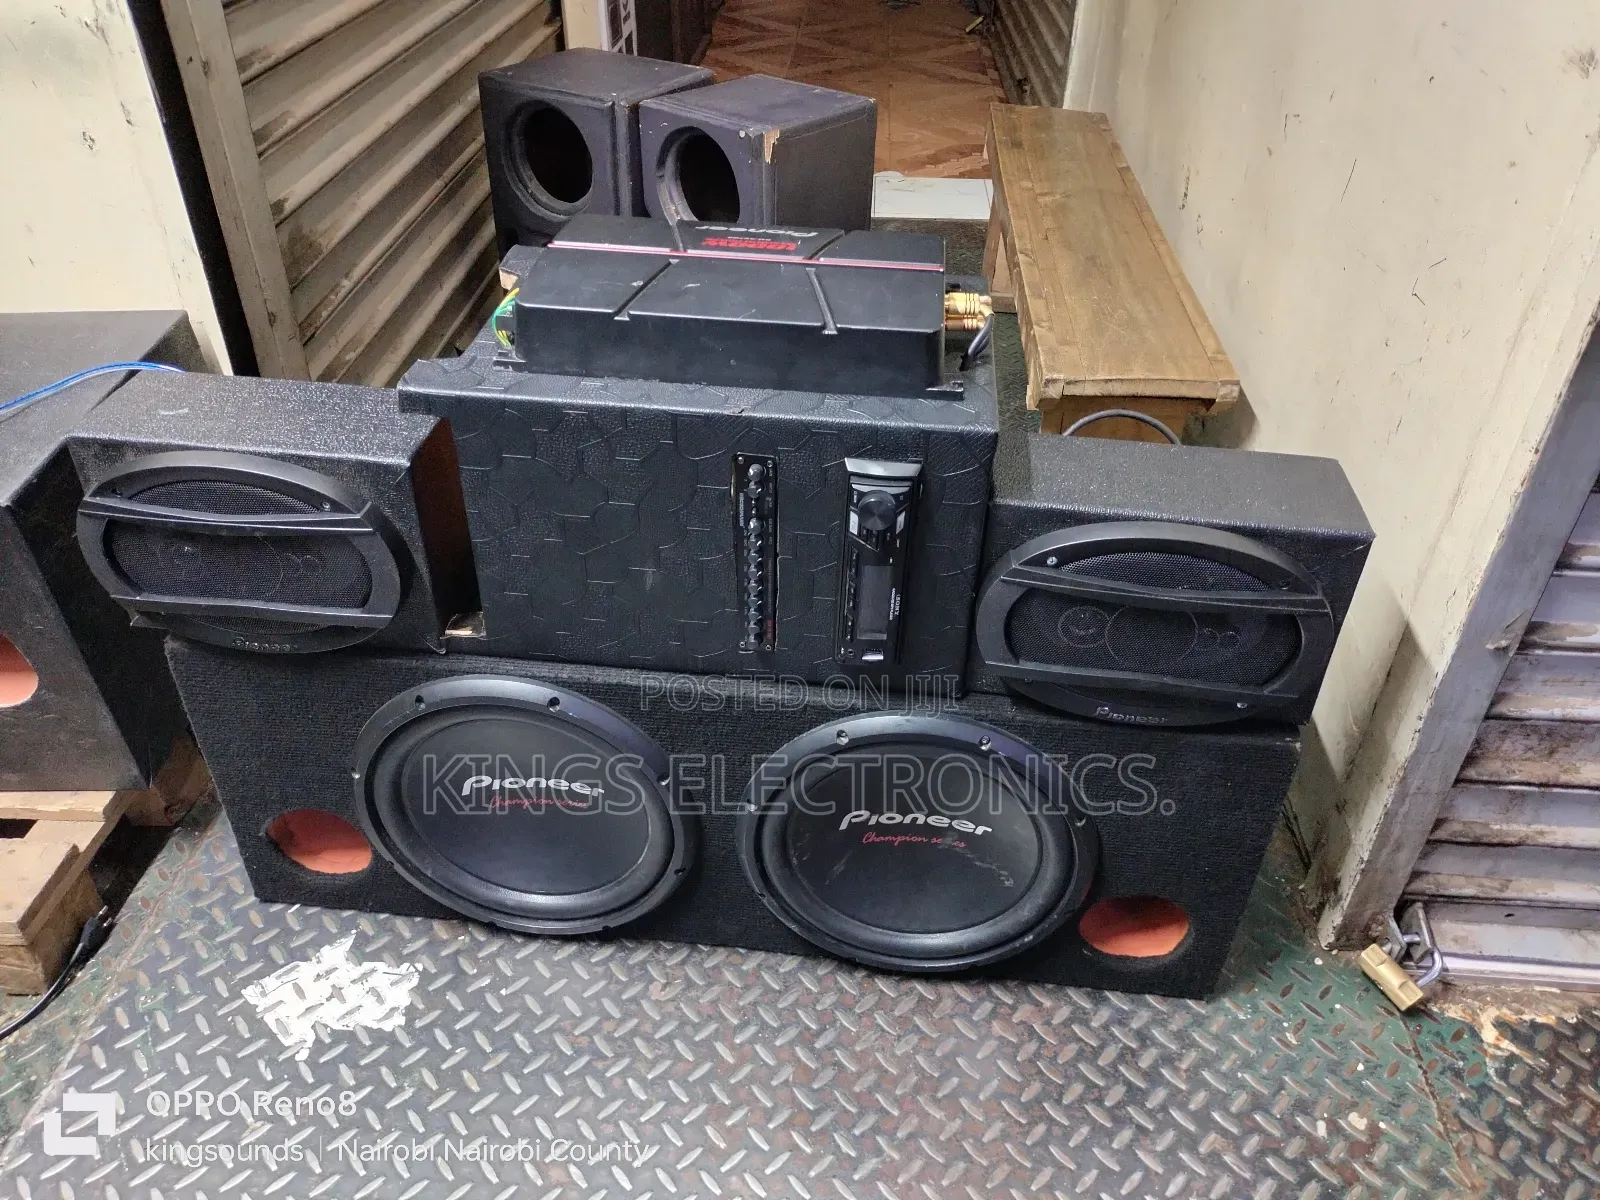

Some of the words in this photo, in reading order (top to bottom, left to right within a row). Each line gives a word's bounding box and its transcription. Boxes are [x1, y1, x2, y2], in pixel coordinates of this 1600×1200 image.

[695, 225, 819, 237] Pioneer
[1094, 706, 1168, 724] Pioneer
[461, 775, 605, 797] Pioneer
[838, 809, 993, 836] Pioneer
[862, 831, 928, 847] Champion
[931, 837, 967, 849] sees
